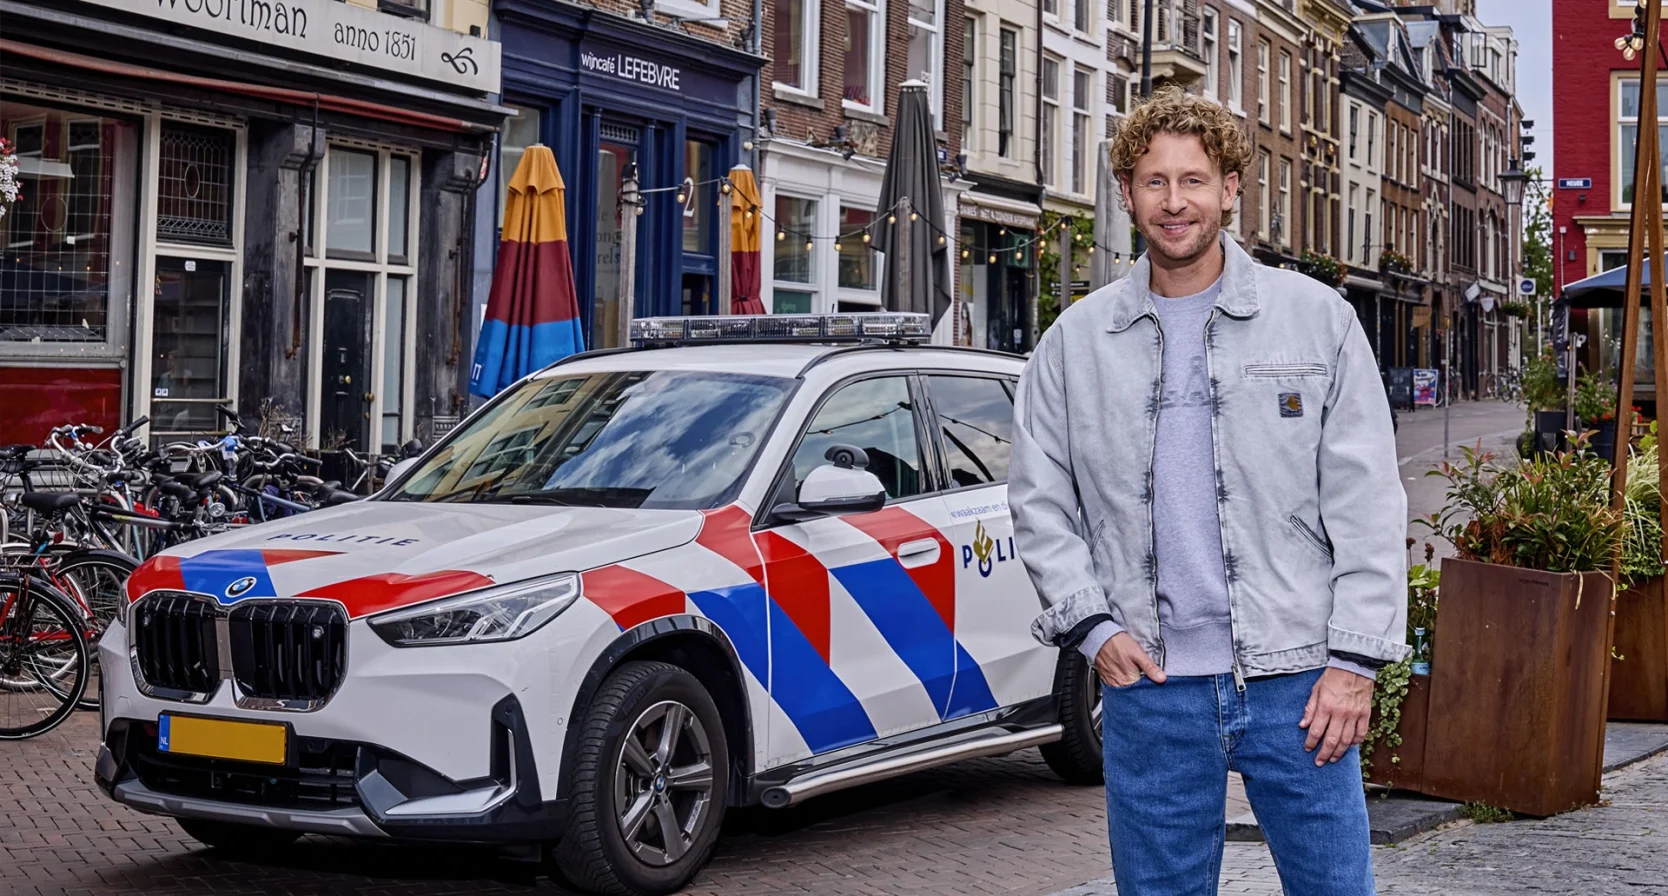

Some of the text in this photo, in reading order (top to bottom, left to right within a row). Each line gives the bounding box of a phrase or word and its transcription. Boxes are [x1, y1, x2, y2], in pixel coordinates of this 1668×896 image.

[334, 22, 379, 51] anno
[384, 30, 416, 61] 1851
[581, 52, 680, 90] wijncafé LEFEBVRE
[683, 176, 695, 217] 2
[266, 533, 420, 547] POLITIE
[160, 736, 169, 745] NL
